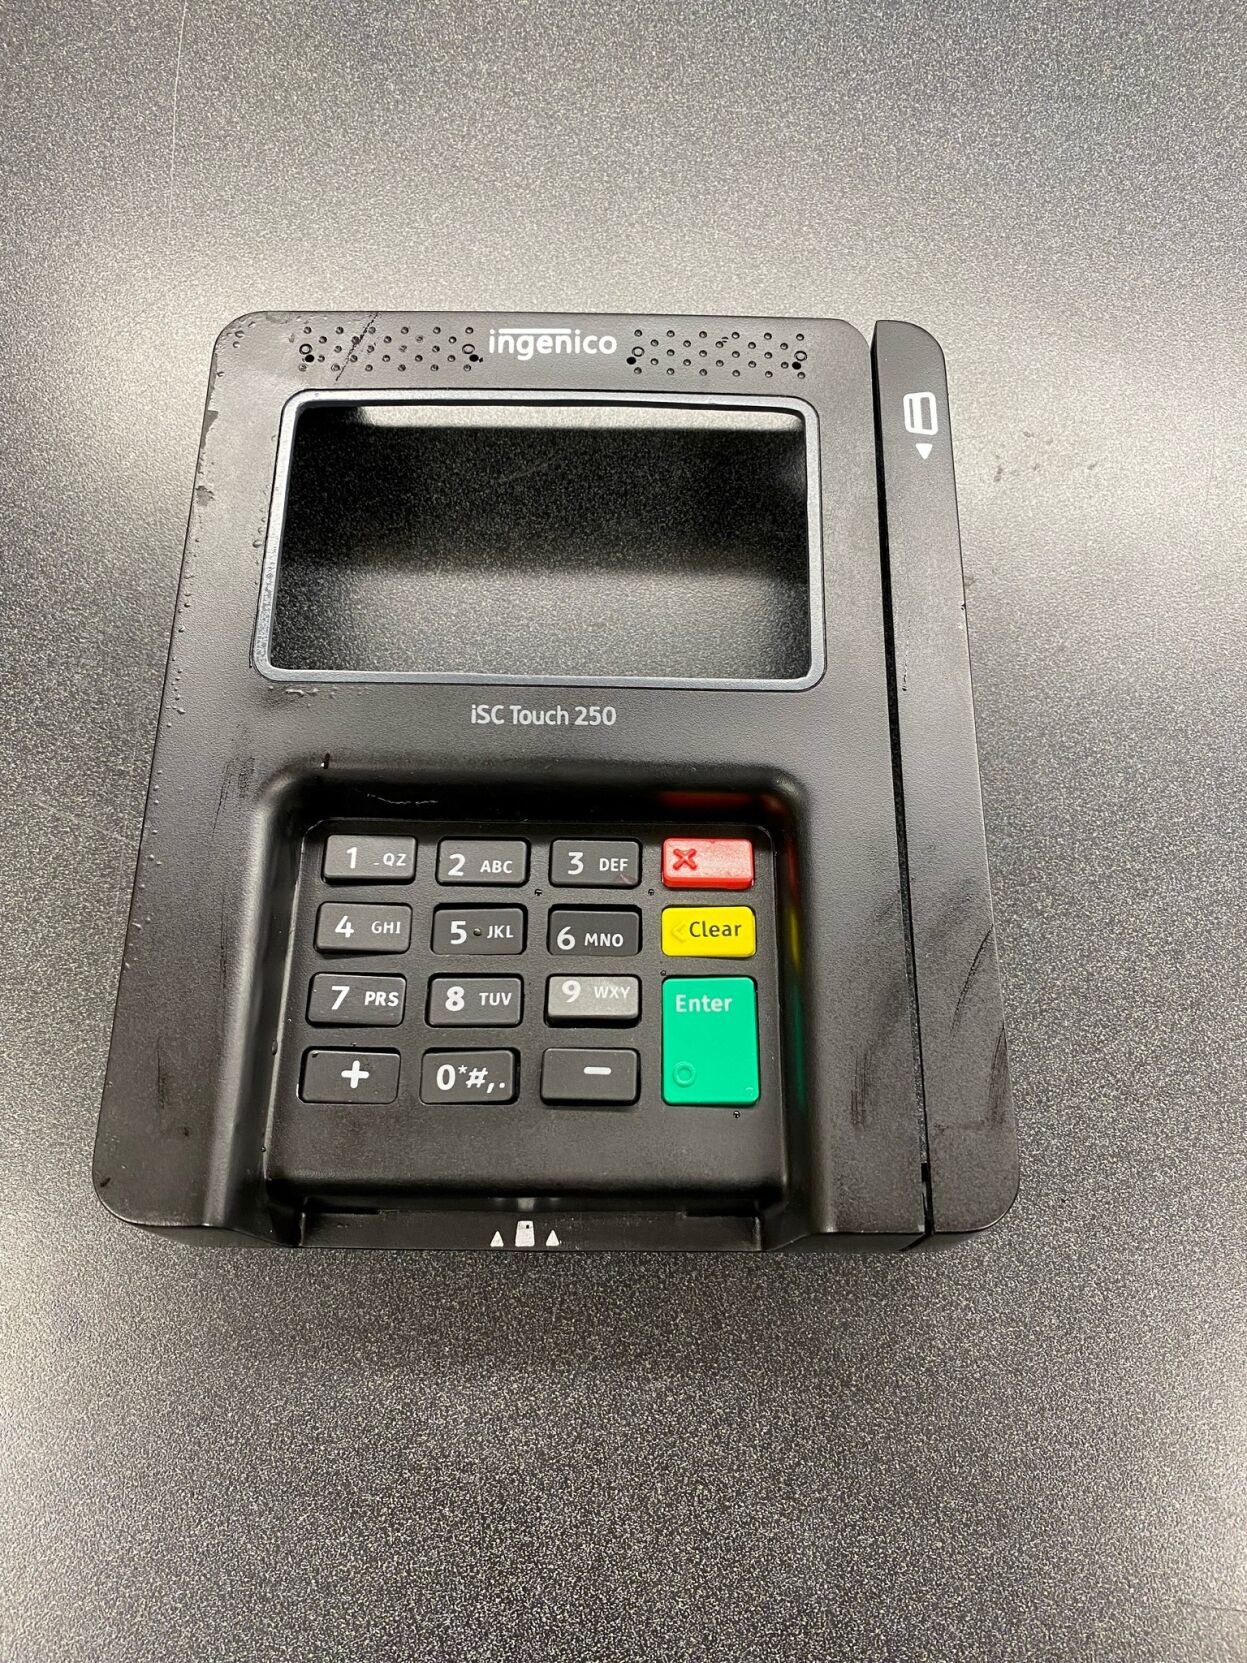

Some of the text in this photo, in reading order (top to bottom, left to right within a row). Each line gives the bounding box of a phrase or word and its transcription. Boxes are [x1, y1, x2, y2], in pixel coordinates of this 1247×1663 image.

[488, 328, 618, 361] ingenico
[470, 703, 617, 726] iSC Touch 250
[345, 846, 358, 870] 1
[447, 853, 513, 877] 2 ABC
[566, 851, 629, 876] 3 DEF
[334, 914, 401, 938] 4 GHI
[449, 920, 514, 945] 5 JKL
[556, 926, 624, 951] 6 MNO
[688, 920, 742, 938] Clear
[330, 985, 400, 1011] 7 PRS
[444, 985, 512, 1012] 8 TUV
[561, 979, 631, 1004] 9 WXY
[674, 993, 733, 1013] Enter
